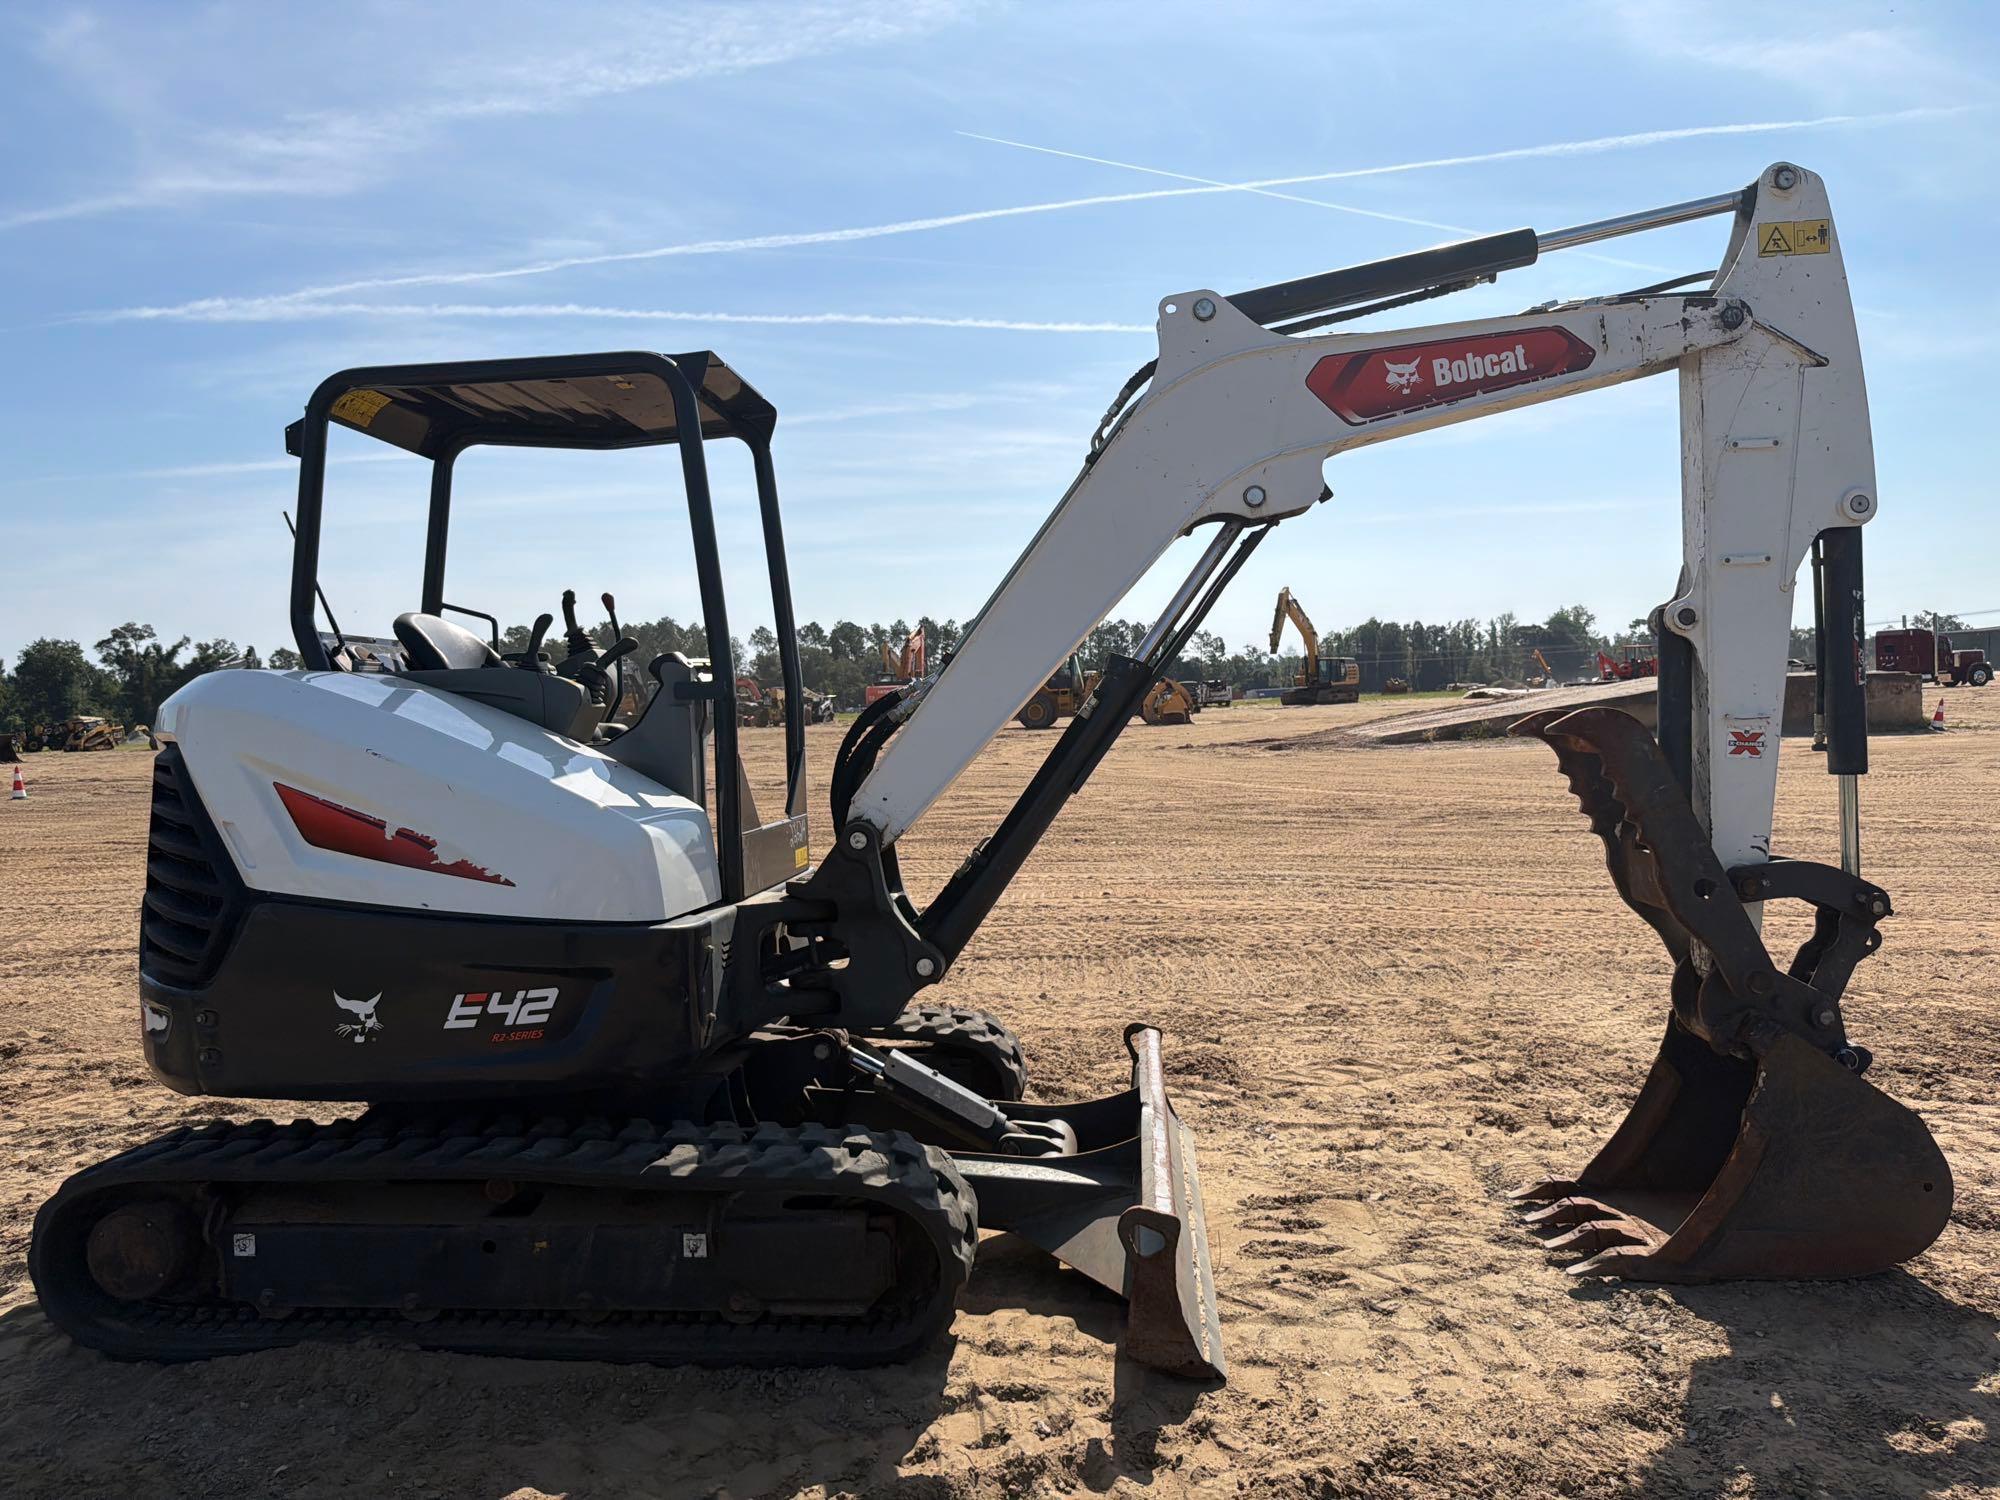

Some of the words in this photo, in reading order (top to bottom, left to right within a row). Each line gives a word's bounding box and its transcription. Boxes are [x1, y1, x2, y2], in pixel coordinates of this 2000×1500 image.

[1432, 344, 1528, 387] Bobcat
[443, 987, 559, 1030] E42
[491, 1029, 544, 1043] R2-SERIES
